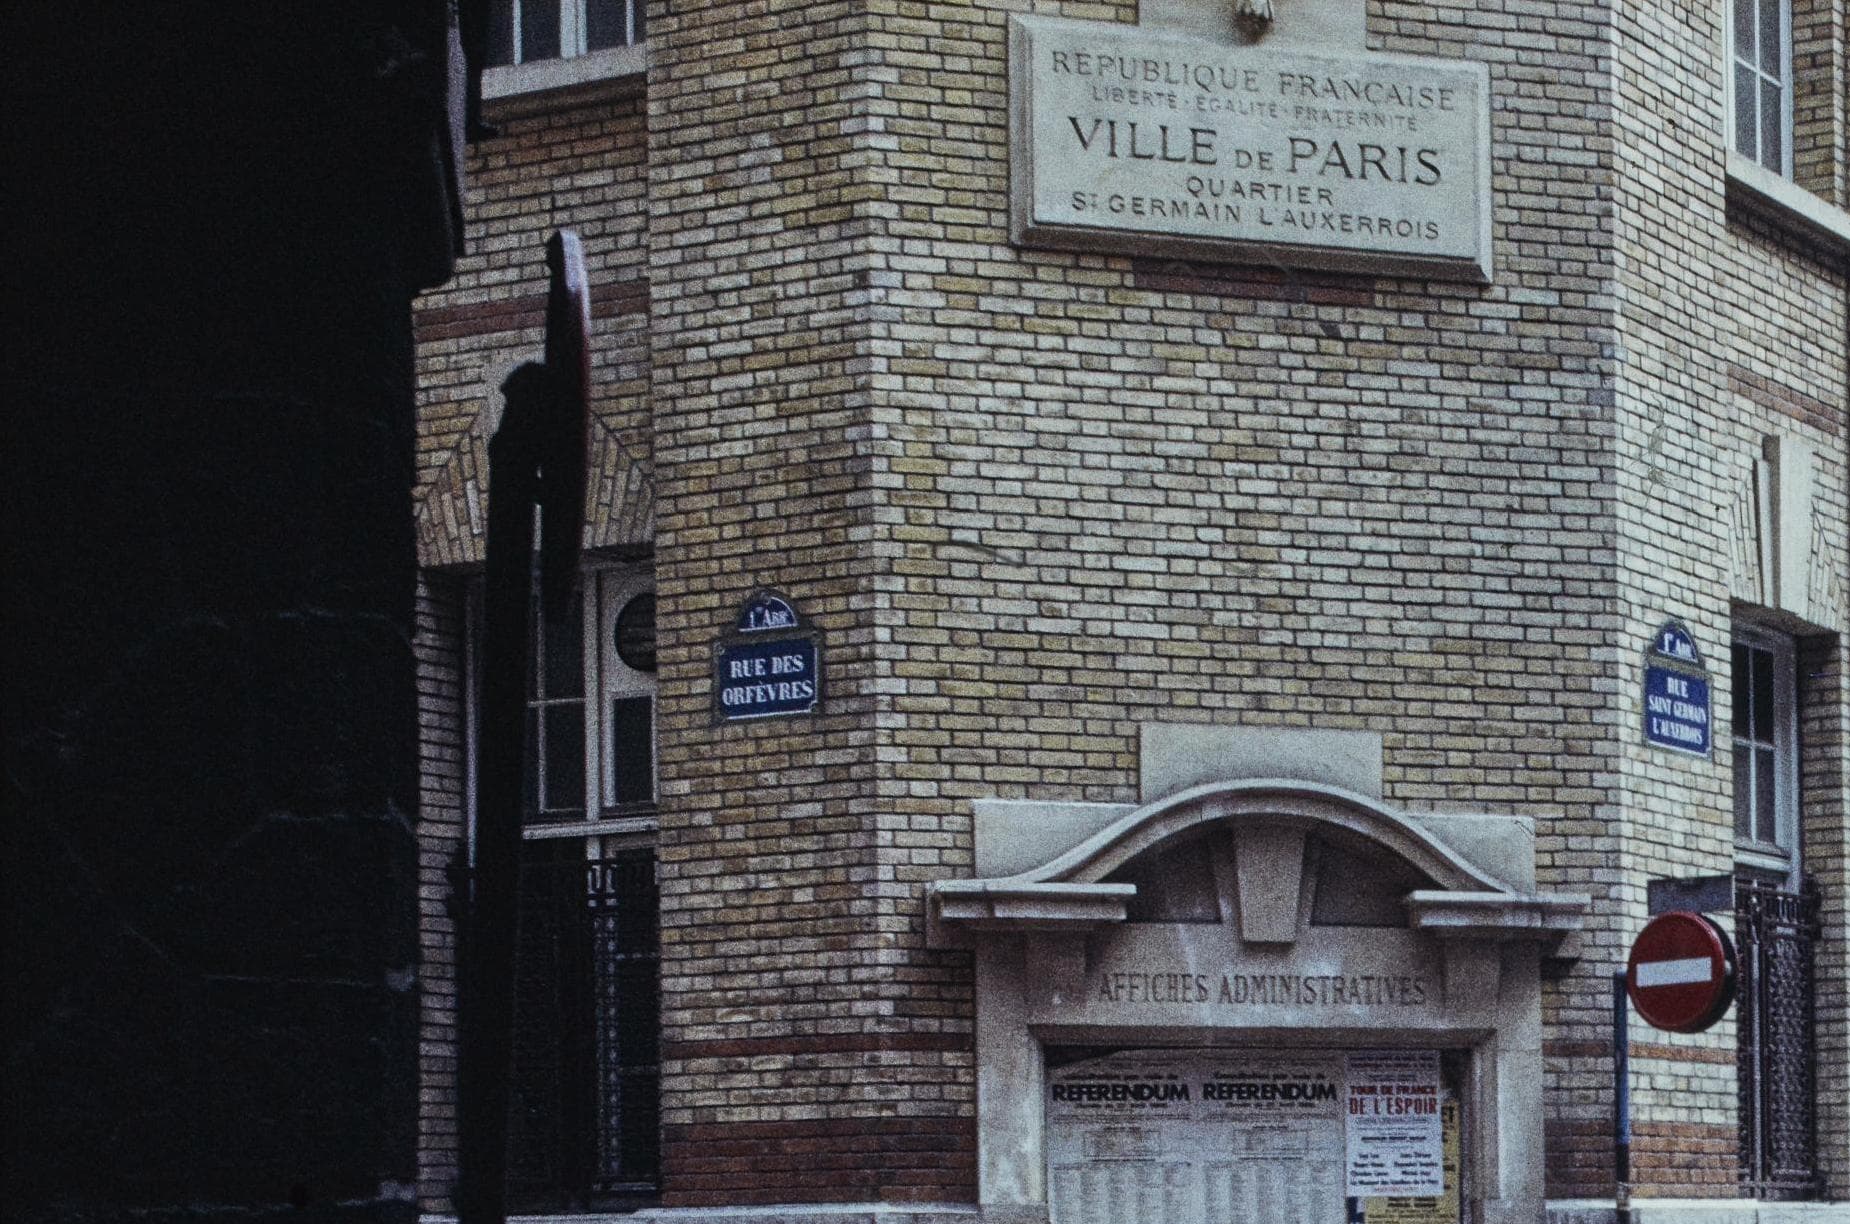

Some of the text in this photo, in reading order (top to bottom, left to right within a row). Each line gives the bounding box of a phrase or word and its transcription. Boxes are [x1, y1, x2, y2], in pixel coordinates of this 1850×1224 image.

[1278, 72, 1455, 112] FRANÇAISE
[1067, 115, 1443, 187] VILLE DE PARIS
[1187, 175, 1333, 206] QUARTIER
[1108, 195, 1241, 225] GERMAIN
[1259, 207, 1440, 240] L'AUXERROIS
[730, 654, 804, 679] RUE DES
[722, 679, 813, 705] ORFÈVRES
[1666, 677, 1689, 698] RUE
[1648, 695, 1707, 723] SAINT GERMAIN
[1099, 972, 1427, 1006] AFFICHES ADMINISTRATIVES
[1052, 1084, 1190, 1102] REFERENDUM
[1203, 1083, 1338, 1101] REFERENDUM
[1350, 1085, 1437, 1095] TOUR DE FRANCE
[1350, 1098, 1366, 1115] DE
